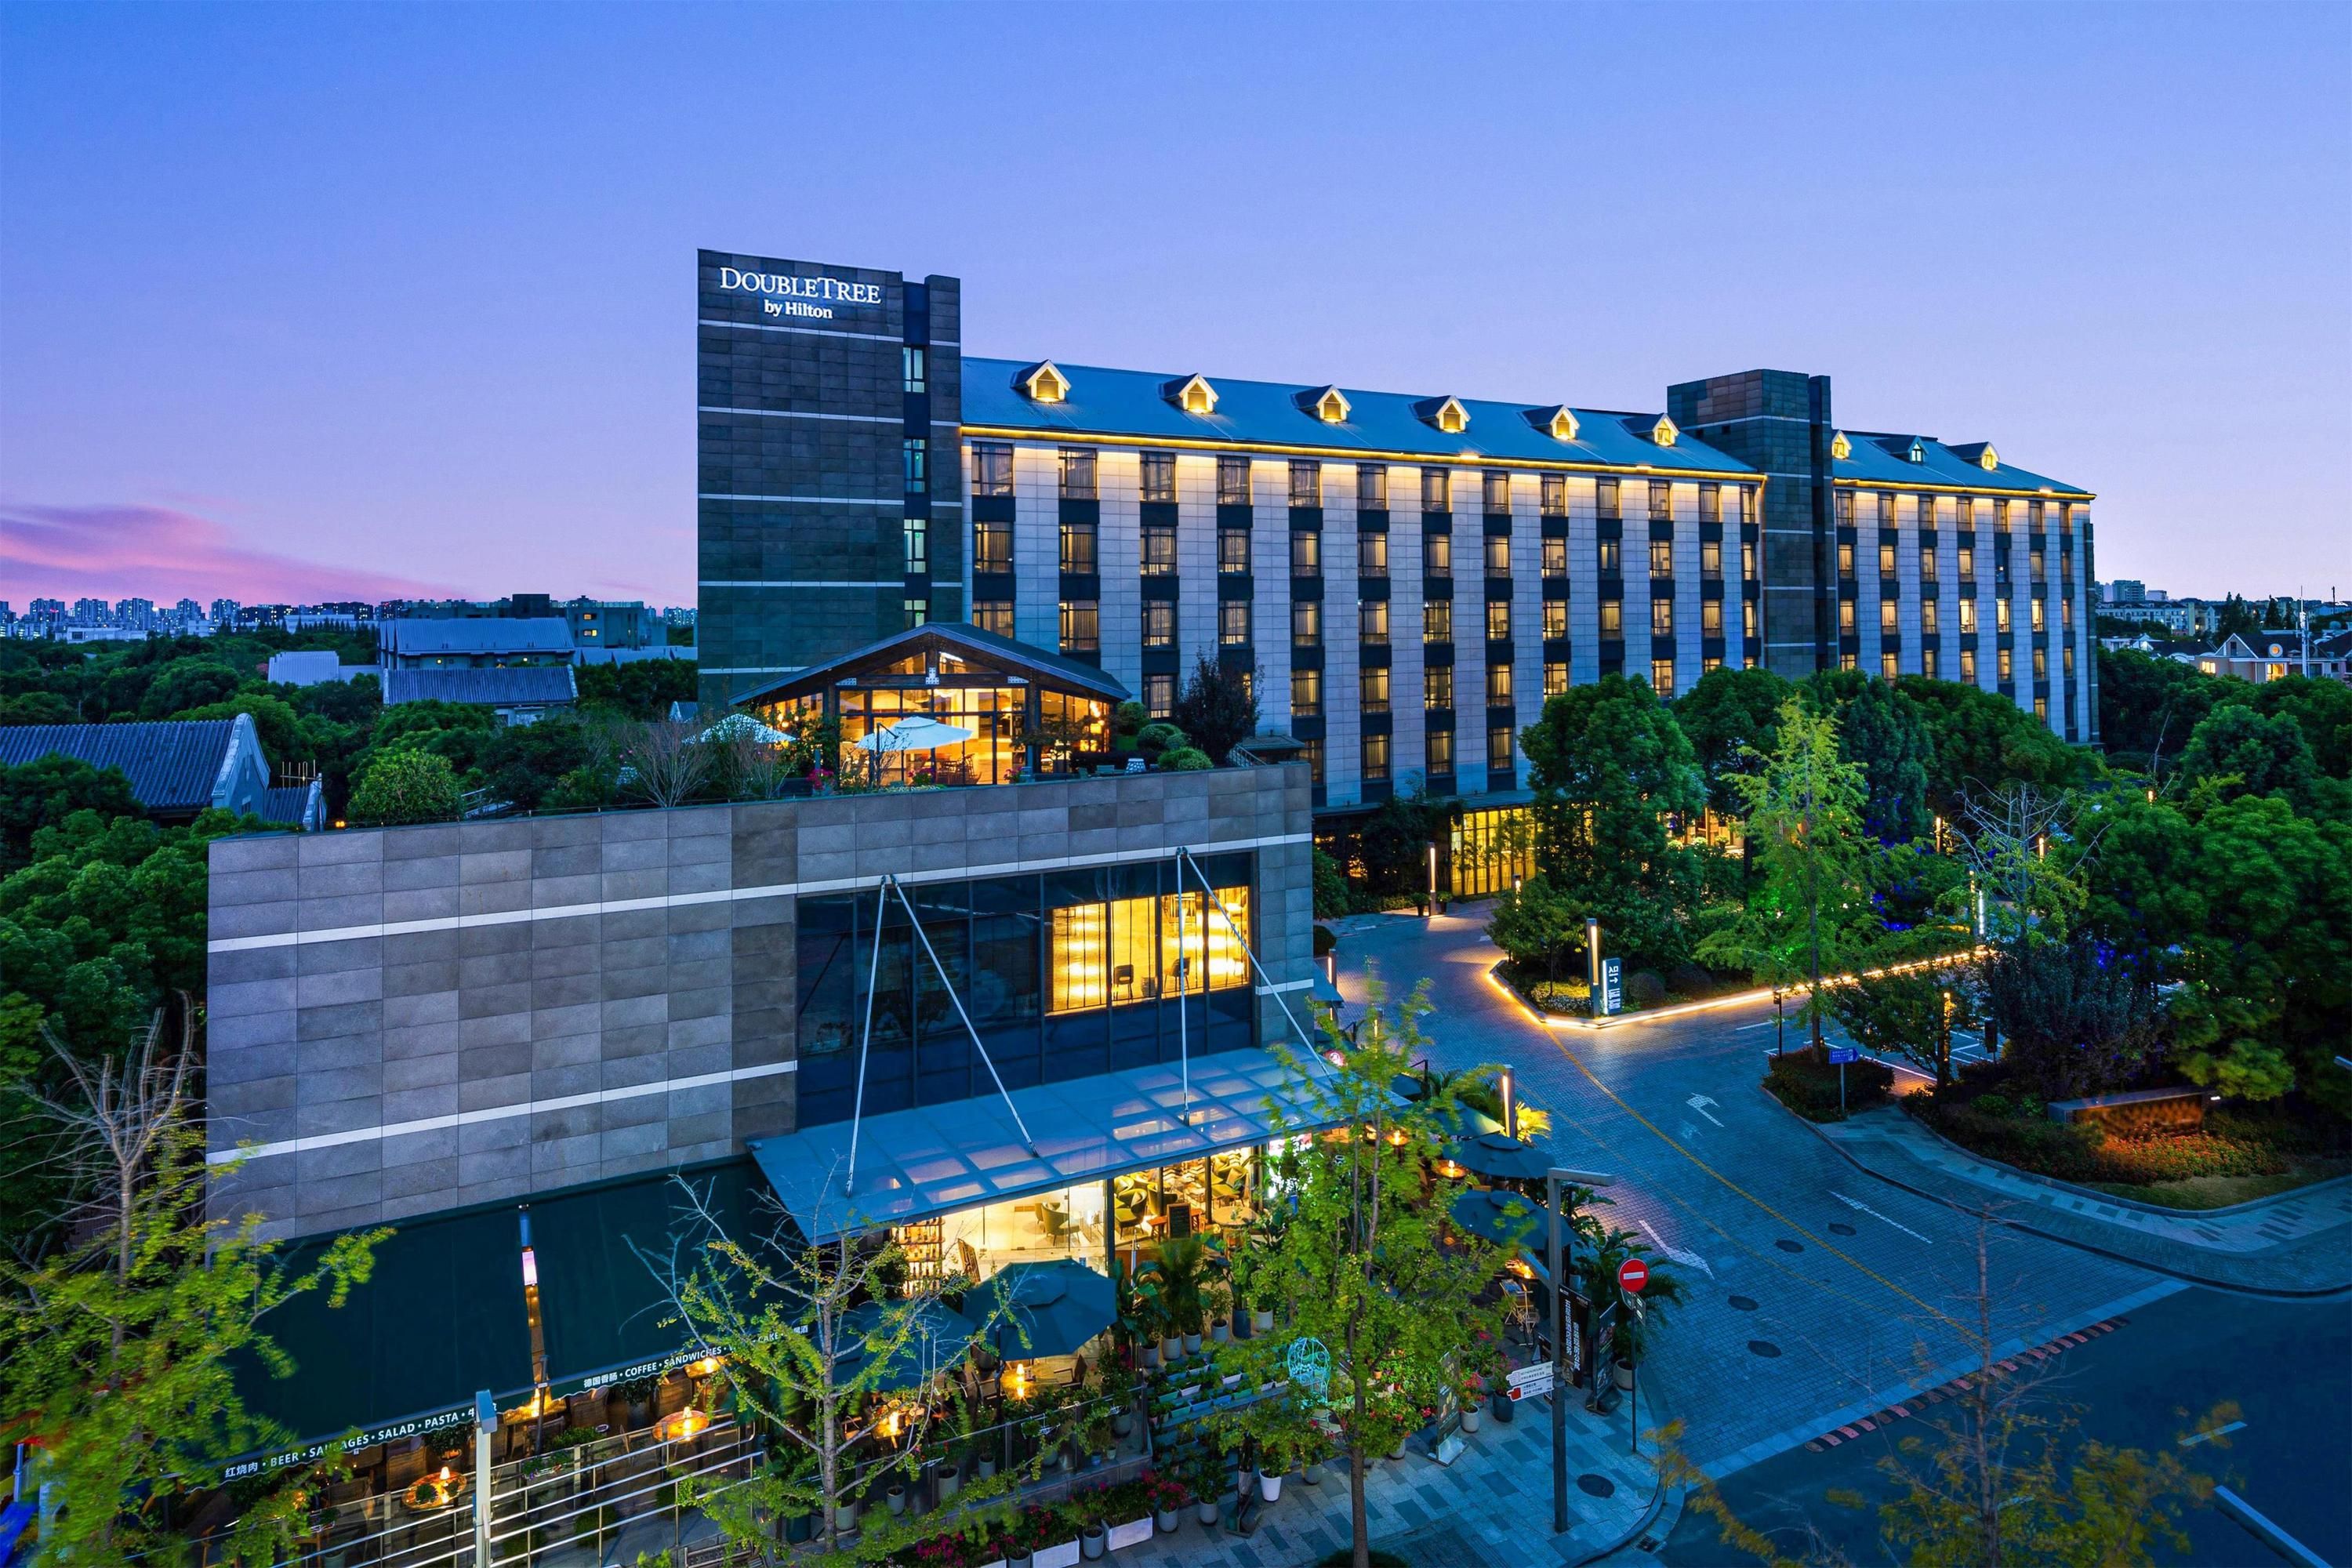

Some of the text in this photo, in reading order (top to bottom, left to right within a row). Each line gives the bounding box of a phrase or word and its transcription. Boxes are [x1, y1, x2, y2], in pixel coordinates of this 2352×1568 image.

[764, 299, 833, 319] by Hilton
[625, 1362, 657, 1377] COFFEE
[663, 1345, 722, 1368] SANDWICHES
[758, 1332, 779, 1342] CAKE
[225, 1461, 259, 1478] 红烧肉
[270, 1452, 299, 1468] BEER
[378, 1423, 416, 1440] SALAD
[424, 1412, 459, 1428] PASTA
